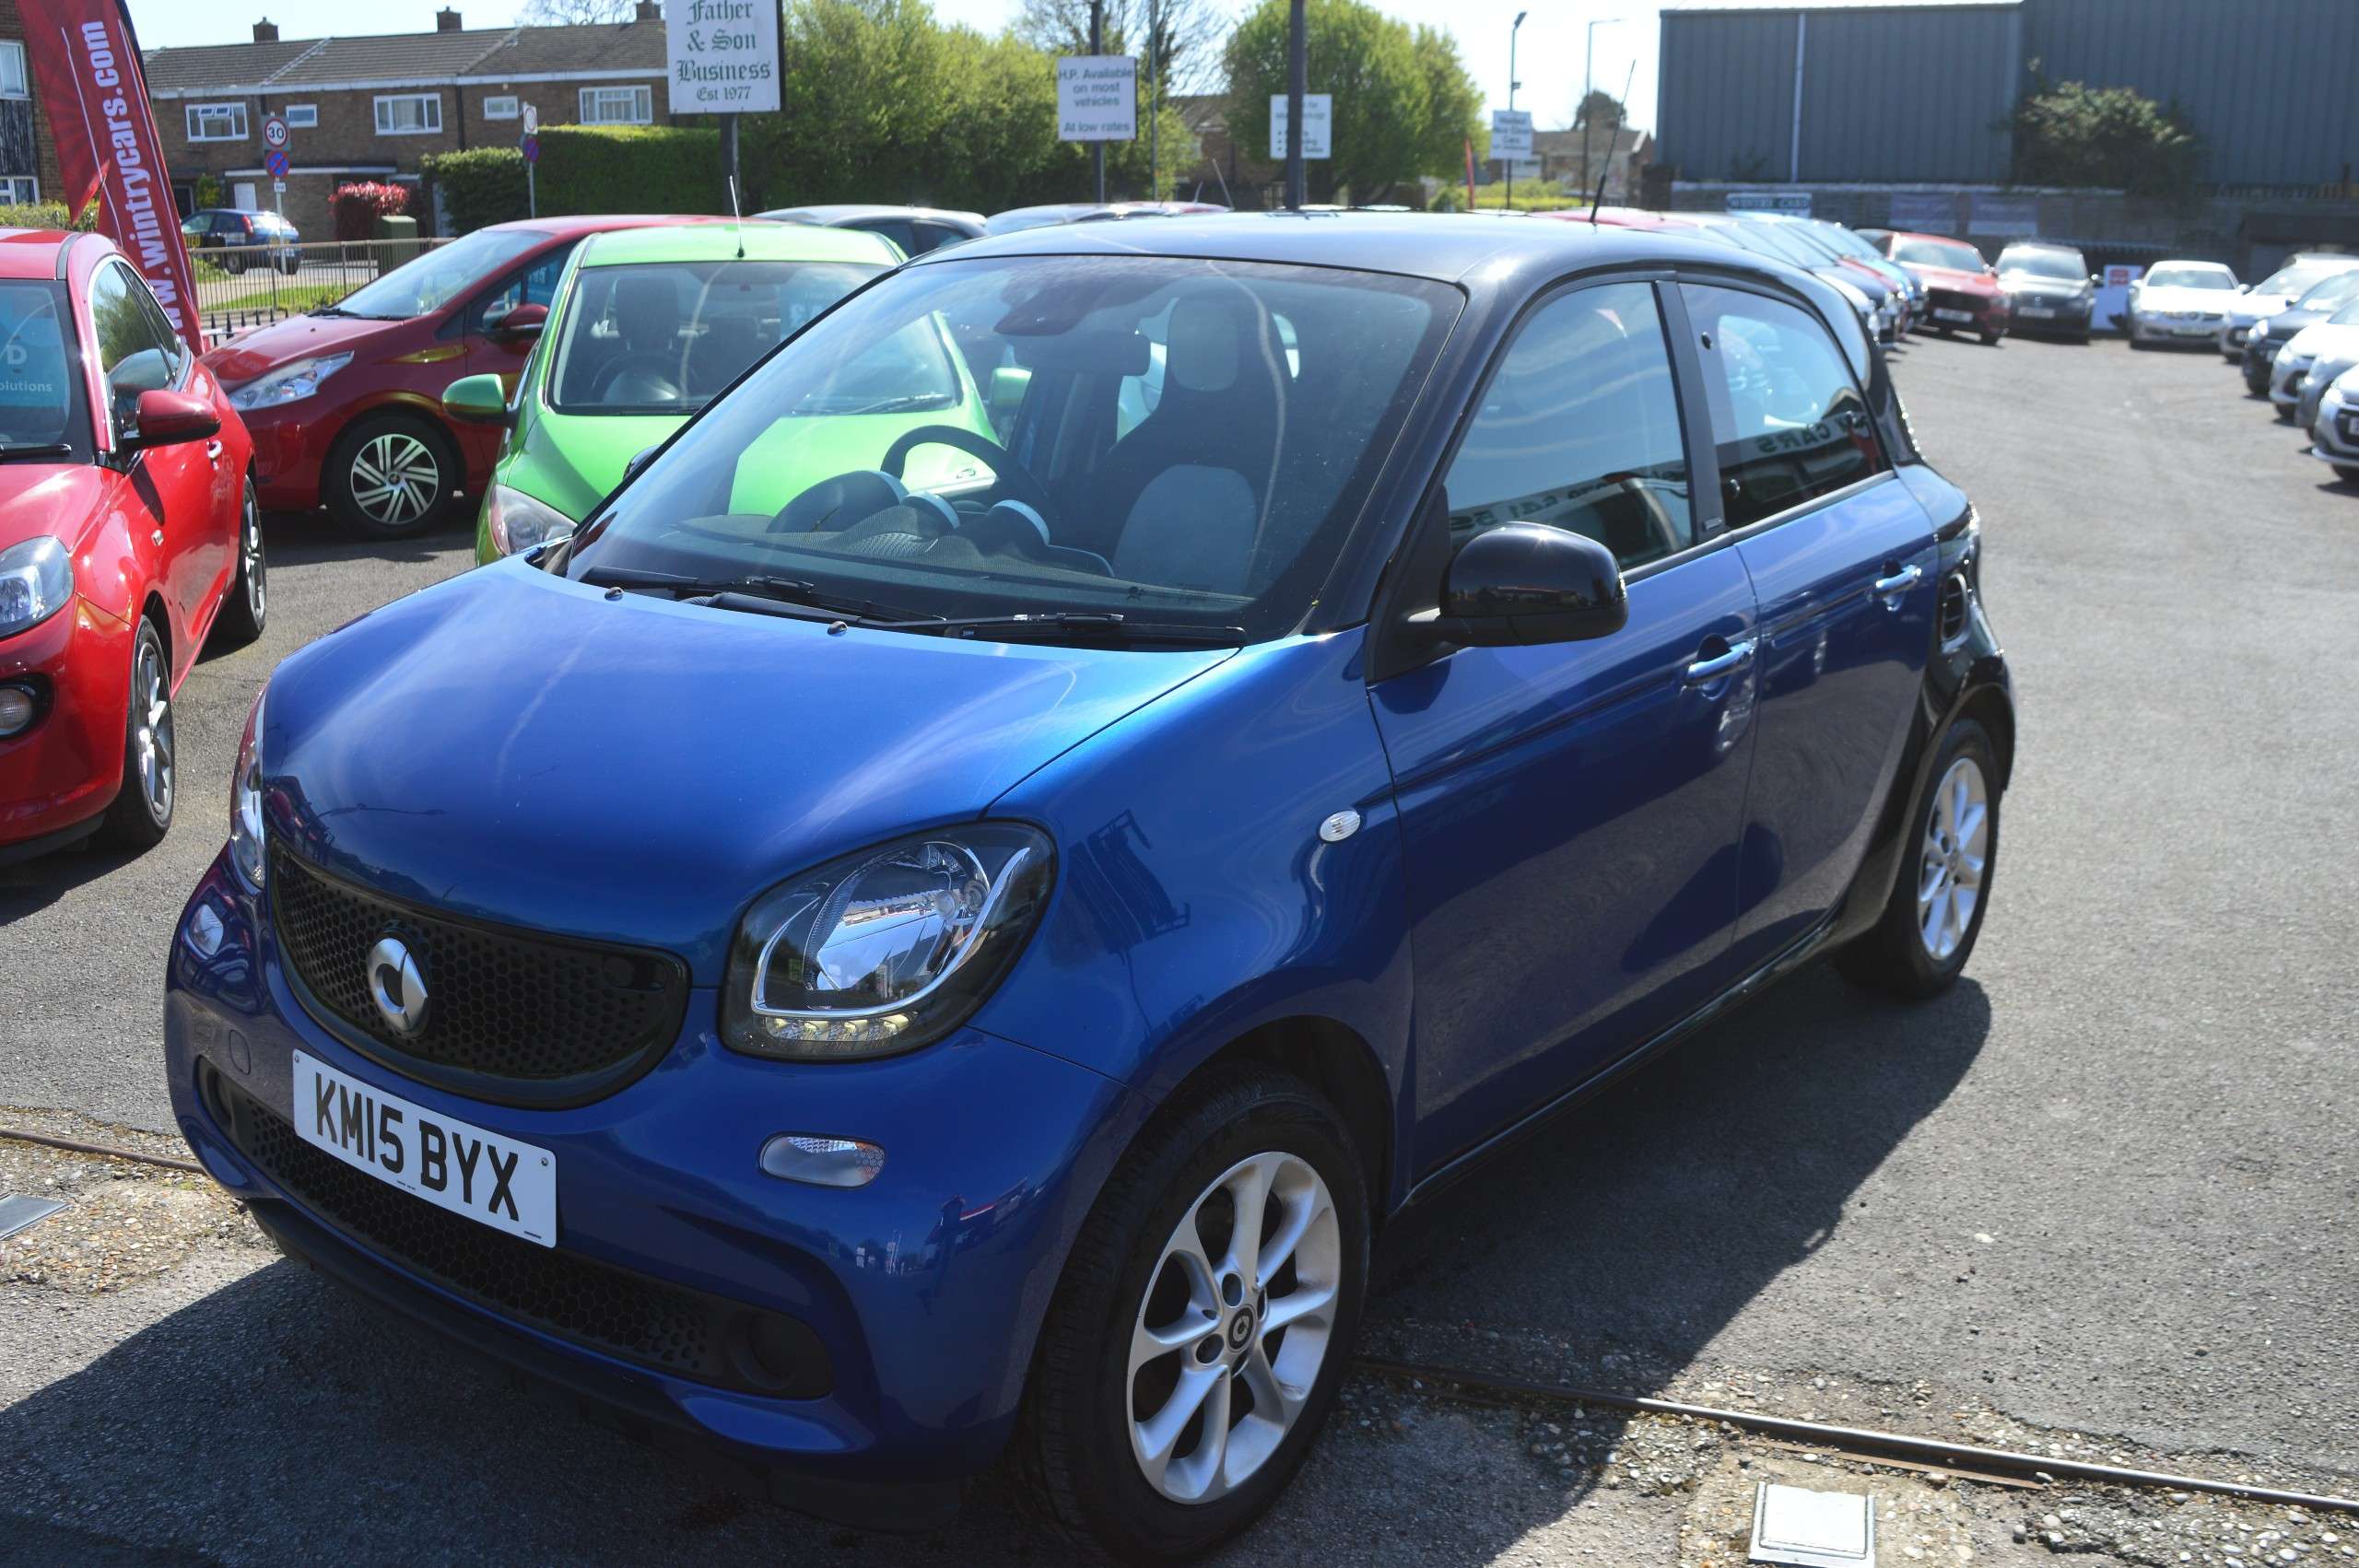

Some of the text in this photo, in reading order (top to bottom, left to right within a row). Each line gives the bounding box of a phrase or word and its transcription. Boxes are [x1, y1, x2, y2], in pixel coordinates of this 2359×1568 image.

[687, 0, 753, 26] Father
[687, 29, 757, 52] & Son
[676, 60, 772, 85] Business
[1083, 67, 1134, 80] Available
[697, 86, 751, 101] Est 1977
[1073, 82, 1120, 94] on most
[1074, 97, 1120, 107] vehicles
[268, 127, 284, 138] 30
[1063, 121, 1131, 132] At low rates
[81, 20, 183, 331] ww.wintrycars.com
[315, 1071, 520, 1223] KM15 BYX
